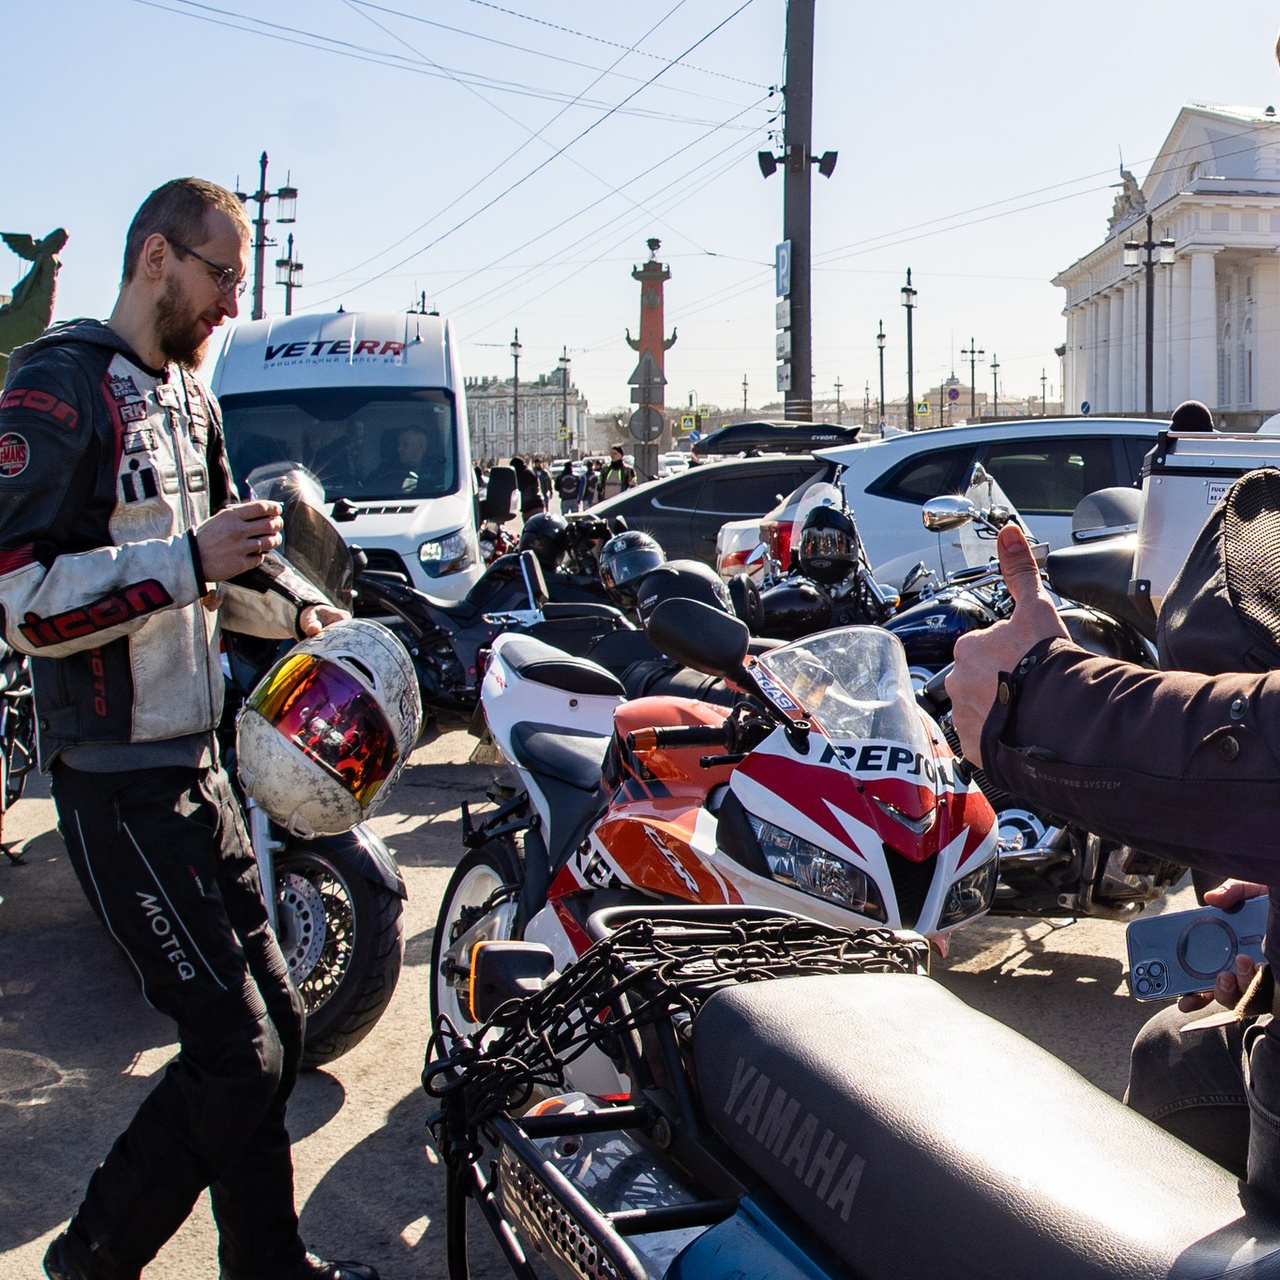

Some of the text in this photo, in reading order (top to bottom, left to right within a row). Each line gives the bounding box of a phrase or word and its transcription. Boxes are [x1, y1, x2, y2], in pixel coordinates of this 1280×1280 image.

[264, 340, 406, 361] VETERR
[0, 389, 79, 429] con
[119, 402, 146, 419] RK
[0, 444, 27, 464] EMANS
[89, 647, 107, 717] OTO
[819, 742, 956, 788] REPSOL
[1083, 780, 1121, 790] SYSTEM
[136, 891, 196, 981] MOTEQ
[723, 1055, 867, 1222] YAMAHA
